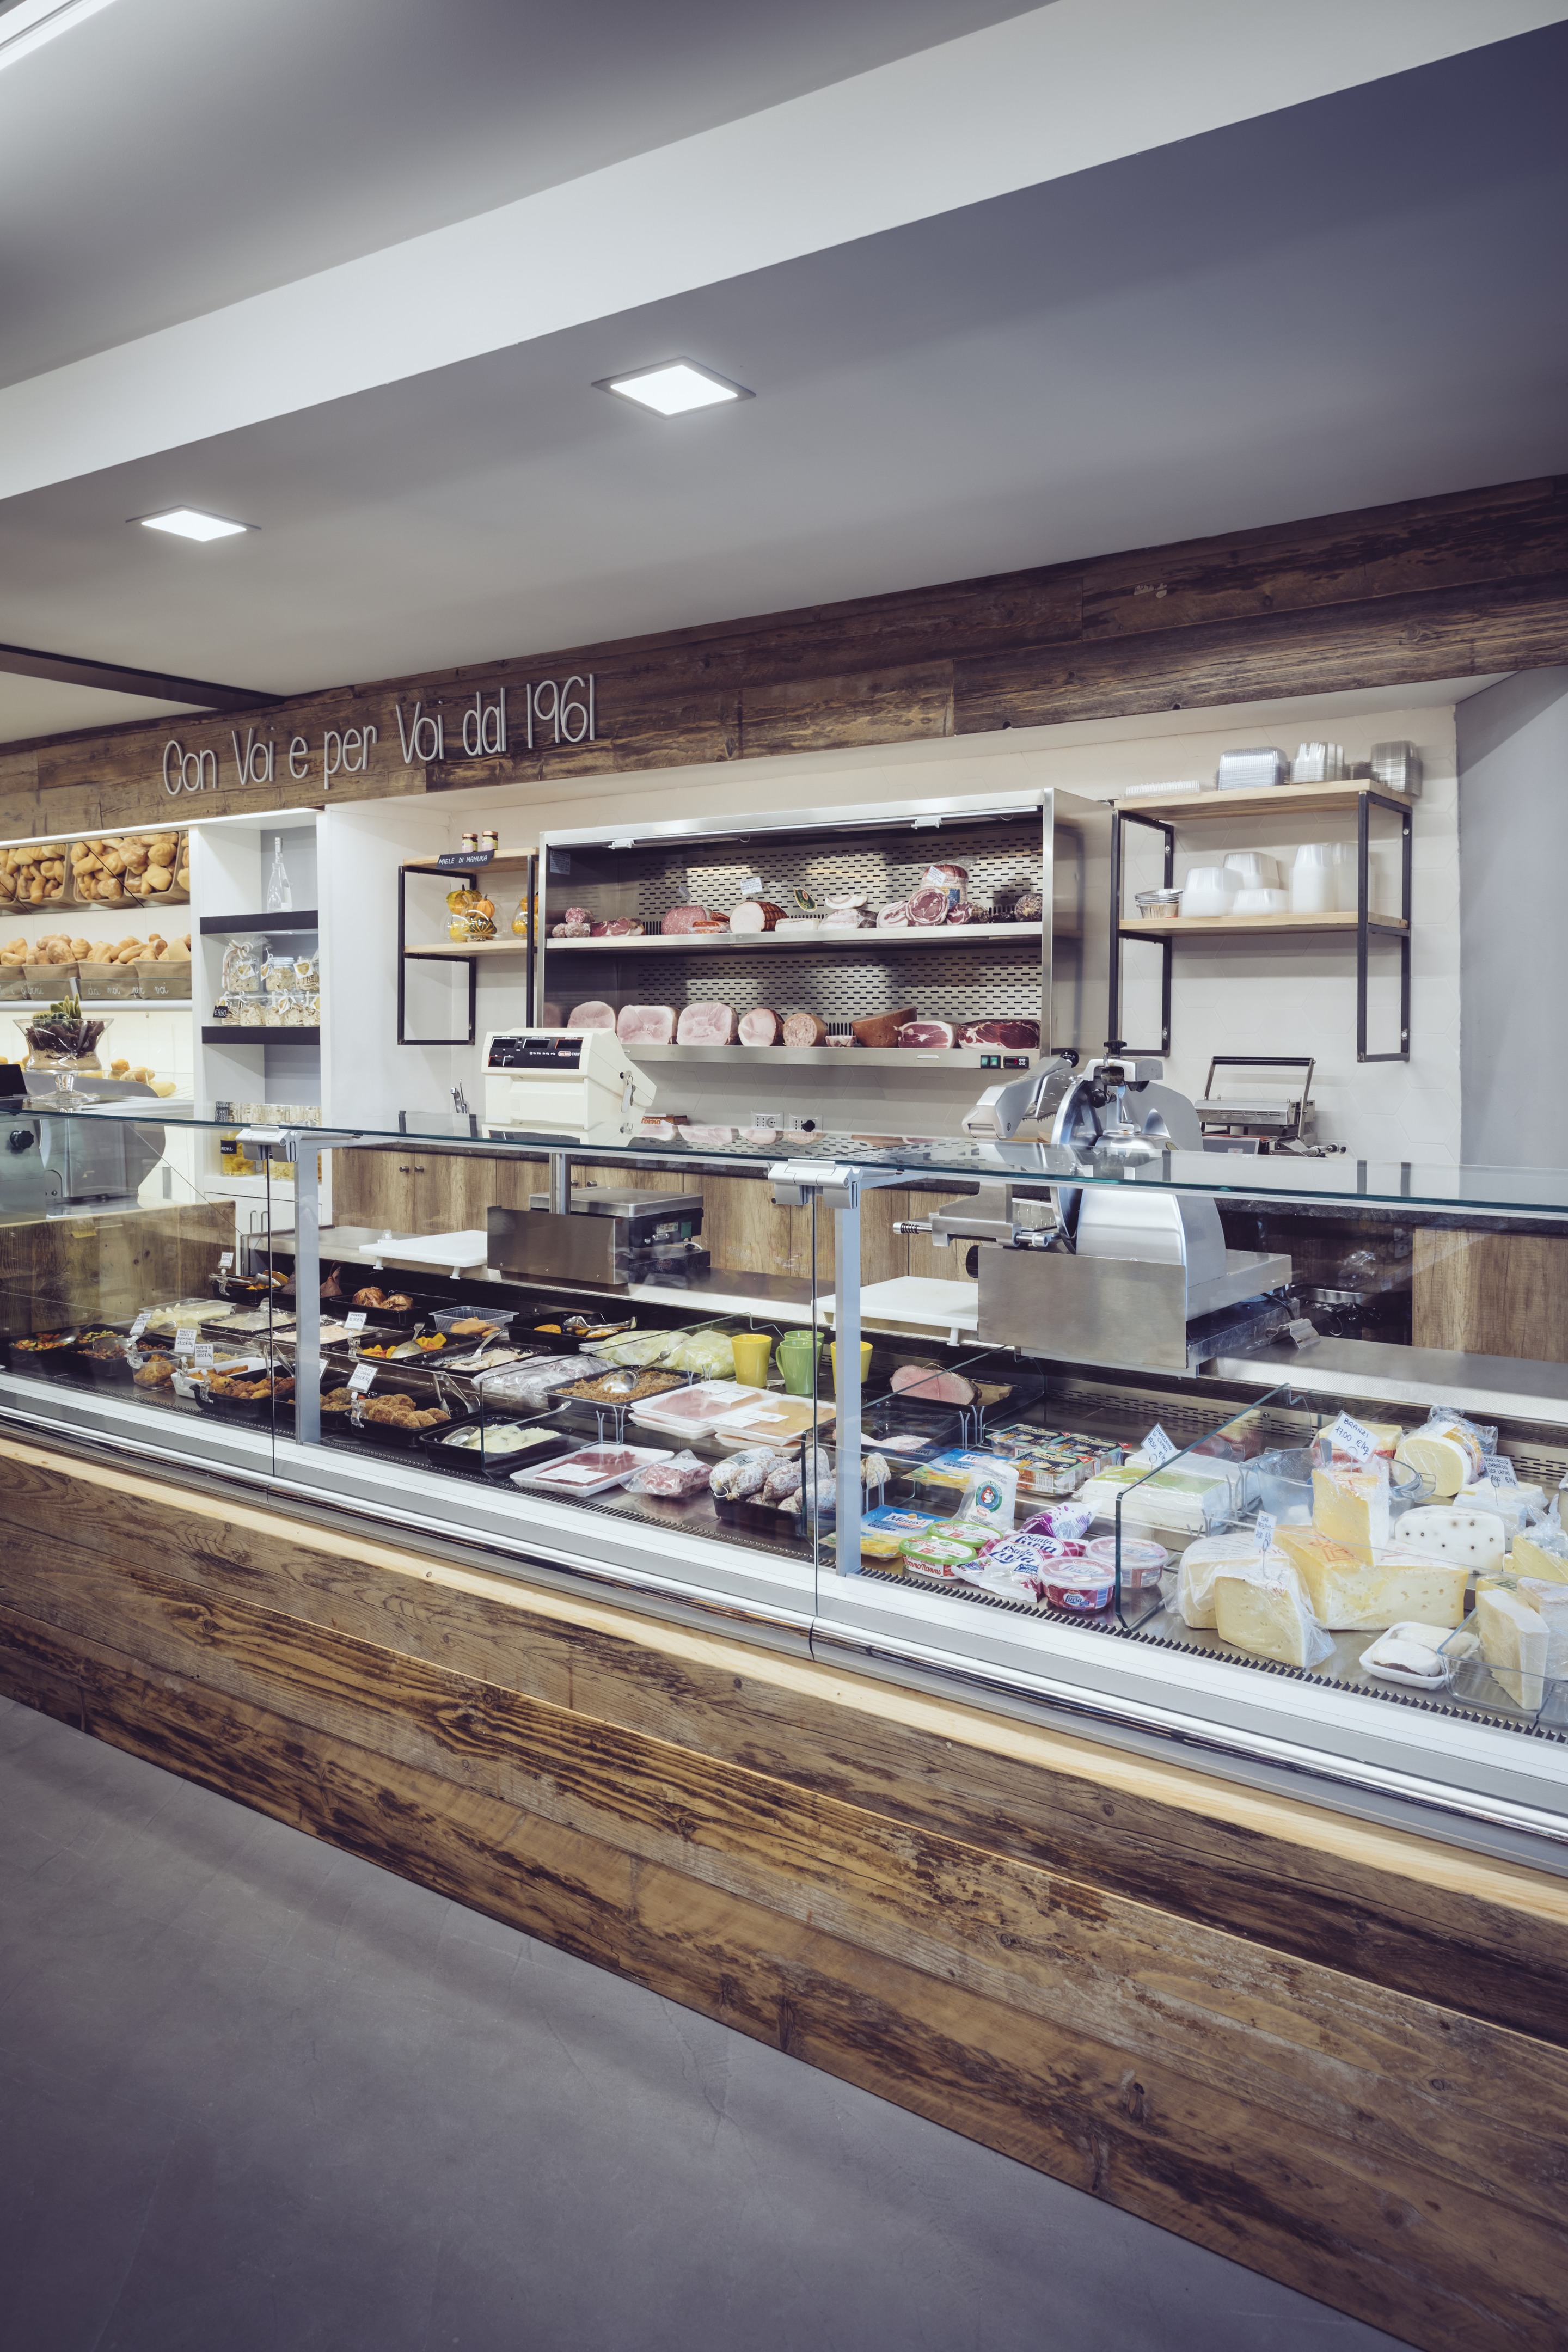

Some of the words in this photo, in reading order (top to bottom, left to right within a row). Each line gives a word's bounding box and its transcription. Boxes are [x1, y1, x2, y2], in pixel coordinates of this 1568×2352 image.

[163, 740, 218, 795] Con
[231, 726, 274, 786] Voi
[289, 736, 308, 779] e
[324, 726, 378, 790] per
[396, 700, 444, 764] Voi
[463, 687, 507, 756] dal
[526, 673, 595, 748] 1961
[466, 855, 488, 863] MANUKA
[88, 982, 101, 996] da
[107, 983, 121, 995] noi
[131, 984, 145, 999] per
[155, 982, 169, 994] voi
[1343, 1418, 1369, 1438] BRANZI
[1155, 1426, 1172, 1451] STRACCHINO
[1157, 1437, 1168, 1453] CAPRA
[948, 1459, 976, 1467] Emment
[1024, 1534, 1054, 1545] Santa
[904, 1558, 921, 1569] Nonno
[921, 1563, 942, 1575] Nanni
